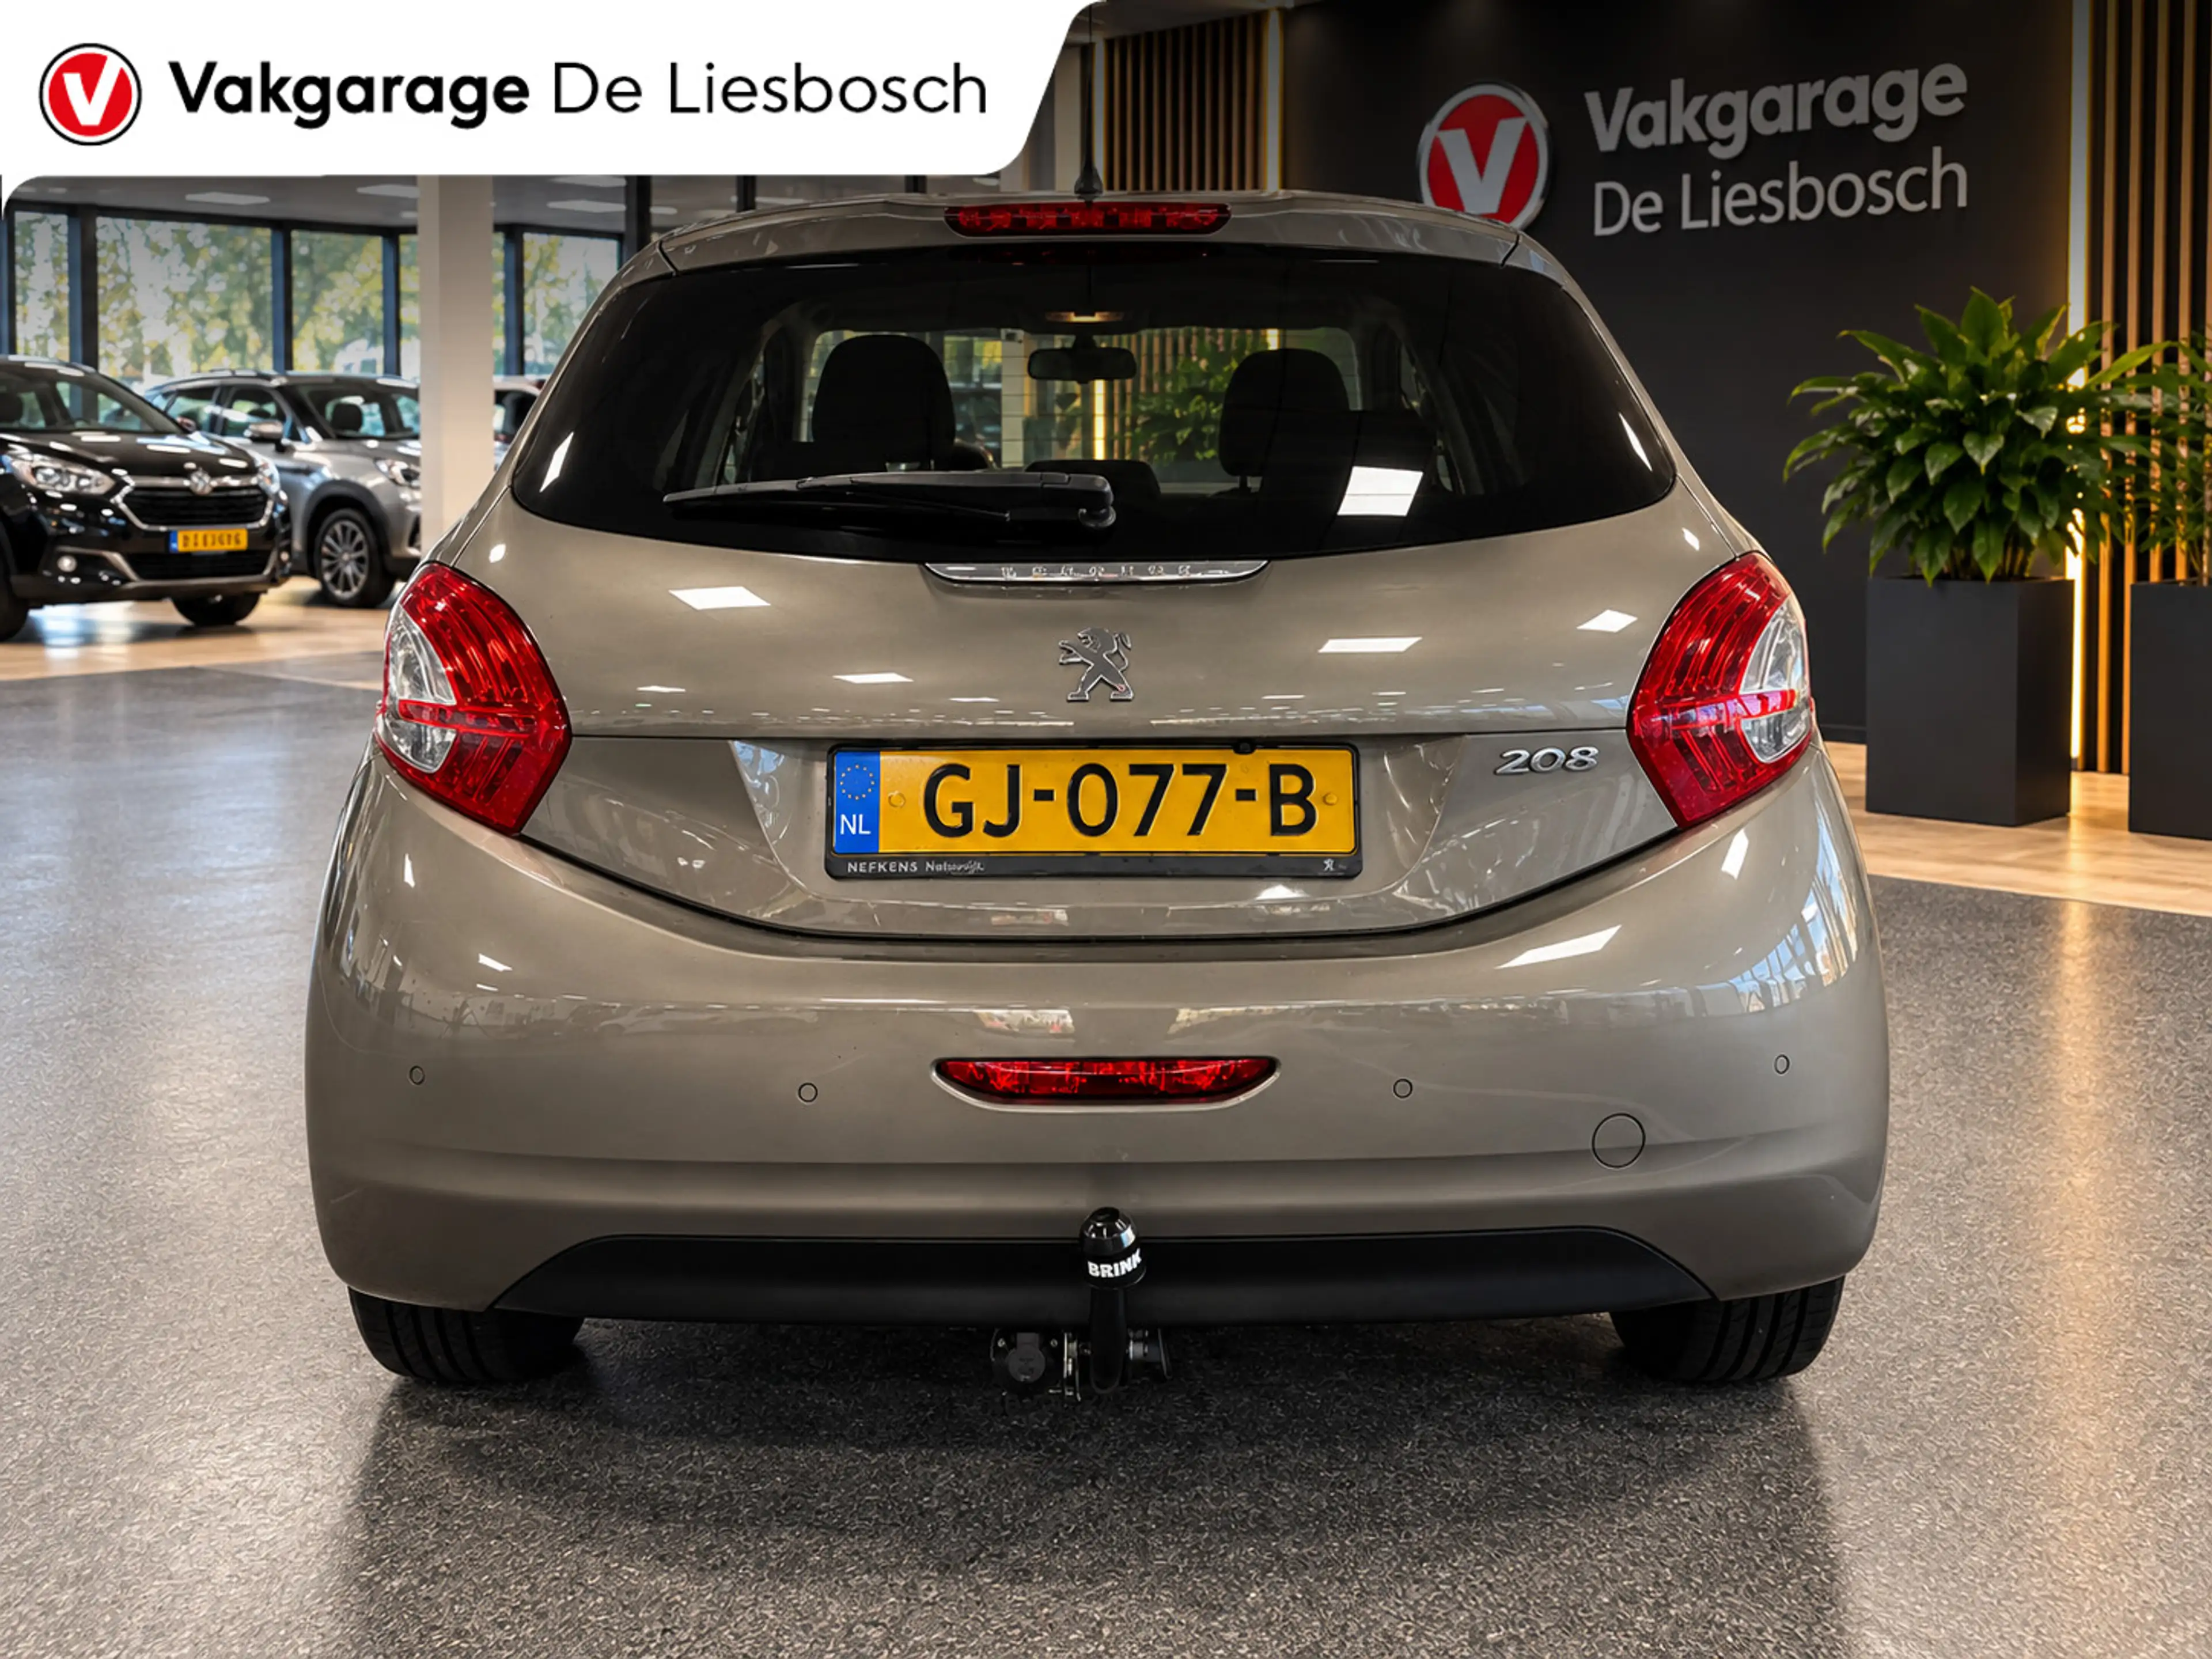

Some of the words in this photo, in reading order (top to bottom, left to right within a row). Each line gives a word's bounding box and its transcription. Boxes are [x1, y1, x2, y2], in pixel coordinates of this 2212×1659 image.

[1584, 63, 1968, 160] Vakgarage
[1593, 181, 1663, 237] De
[1680, 146, 1968, 230] Liesbosch
[1495, 747, 1599, 774] 208
[924, 763, 1317, 838] GJ-077-B
[840, 814, 871, 835] NL
[847, 861, 918, 873] NEFKENS
[1087, 1248, 1142, 1278] BRINK
